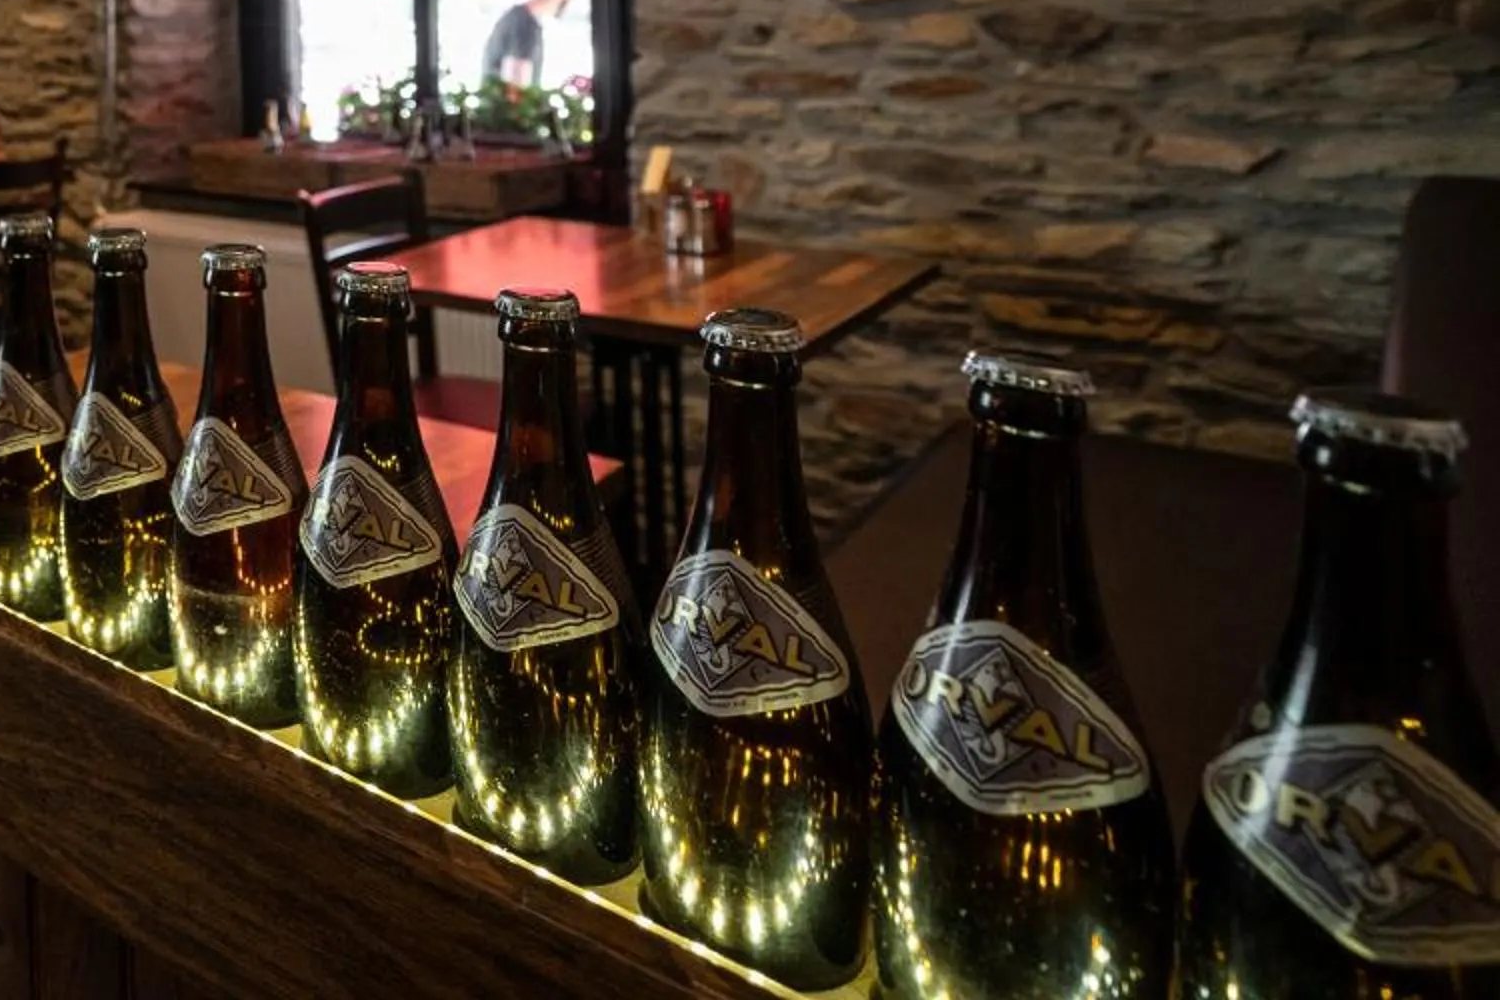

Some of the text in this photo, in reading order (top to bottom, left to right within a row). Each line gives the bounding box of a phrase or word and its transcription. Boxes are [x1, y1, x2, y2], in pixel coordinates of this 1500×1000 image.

[465, 549, 586, 616] RVAL
[905, 660, 1111, 771] ORVAL
[1231, 768, 1500, 899] ORVA
